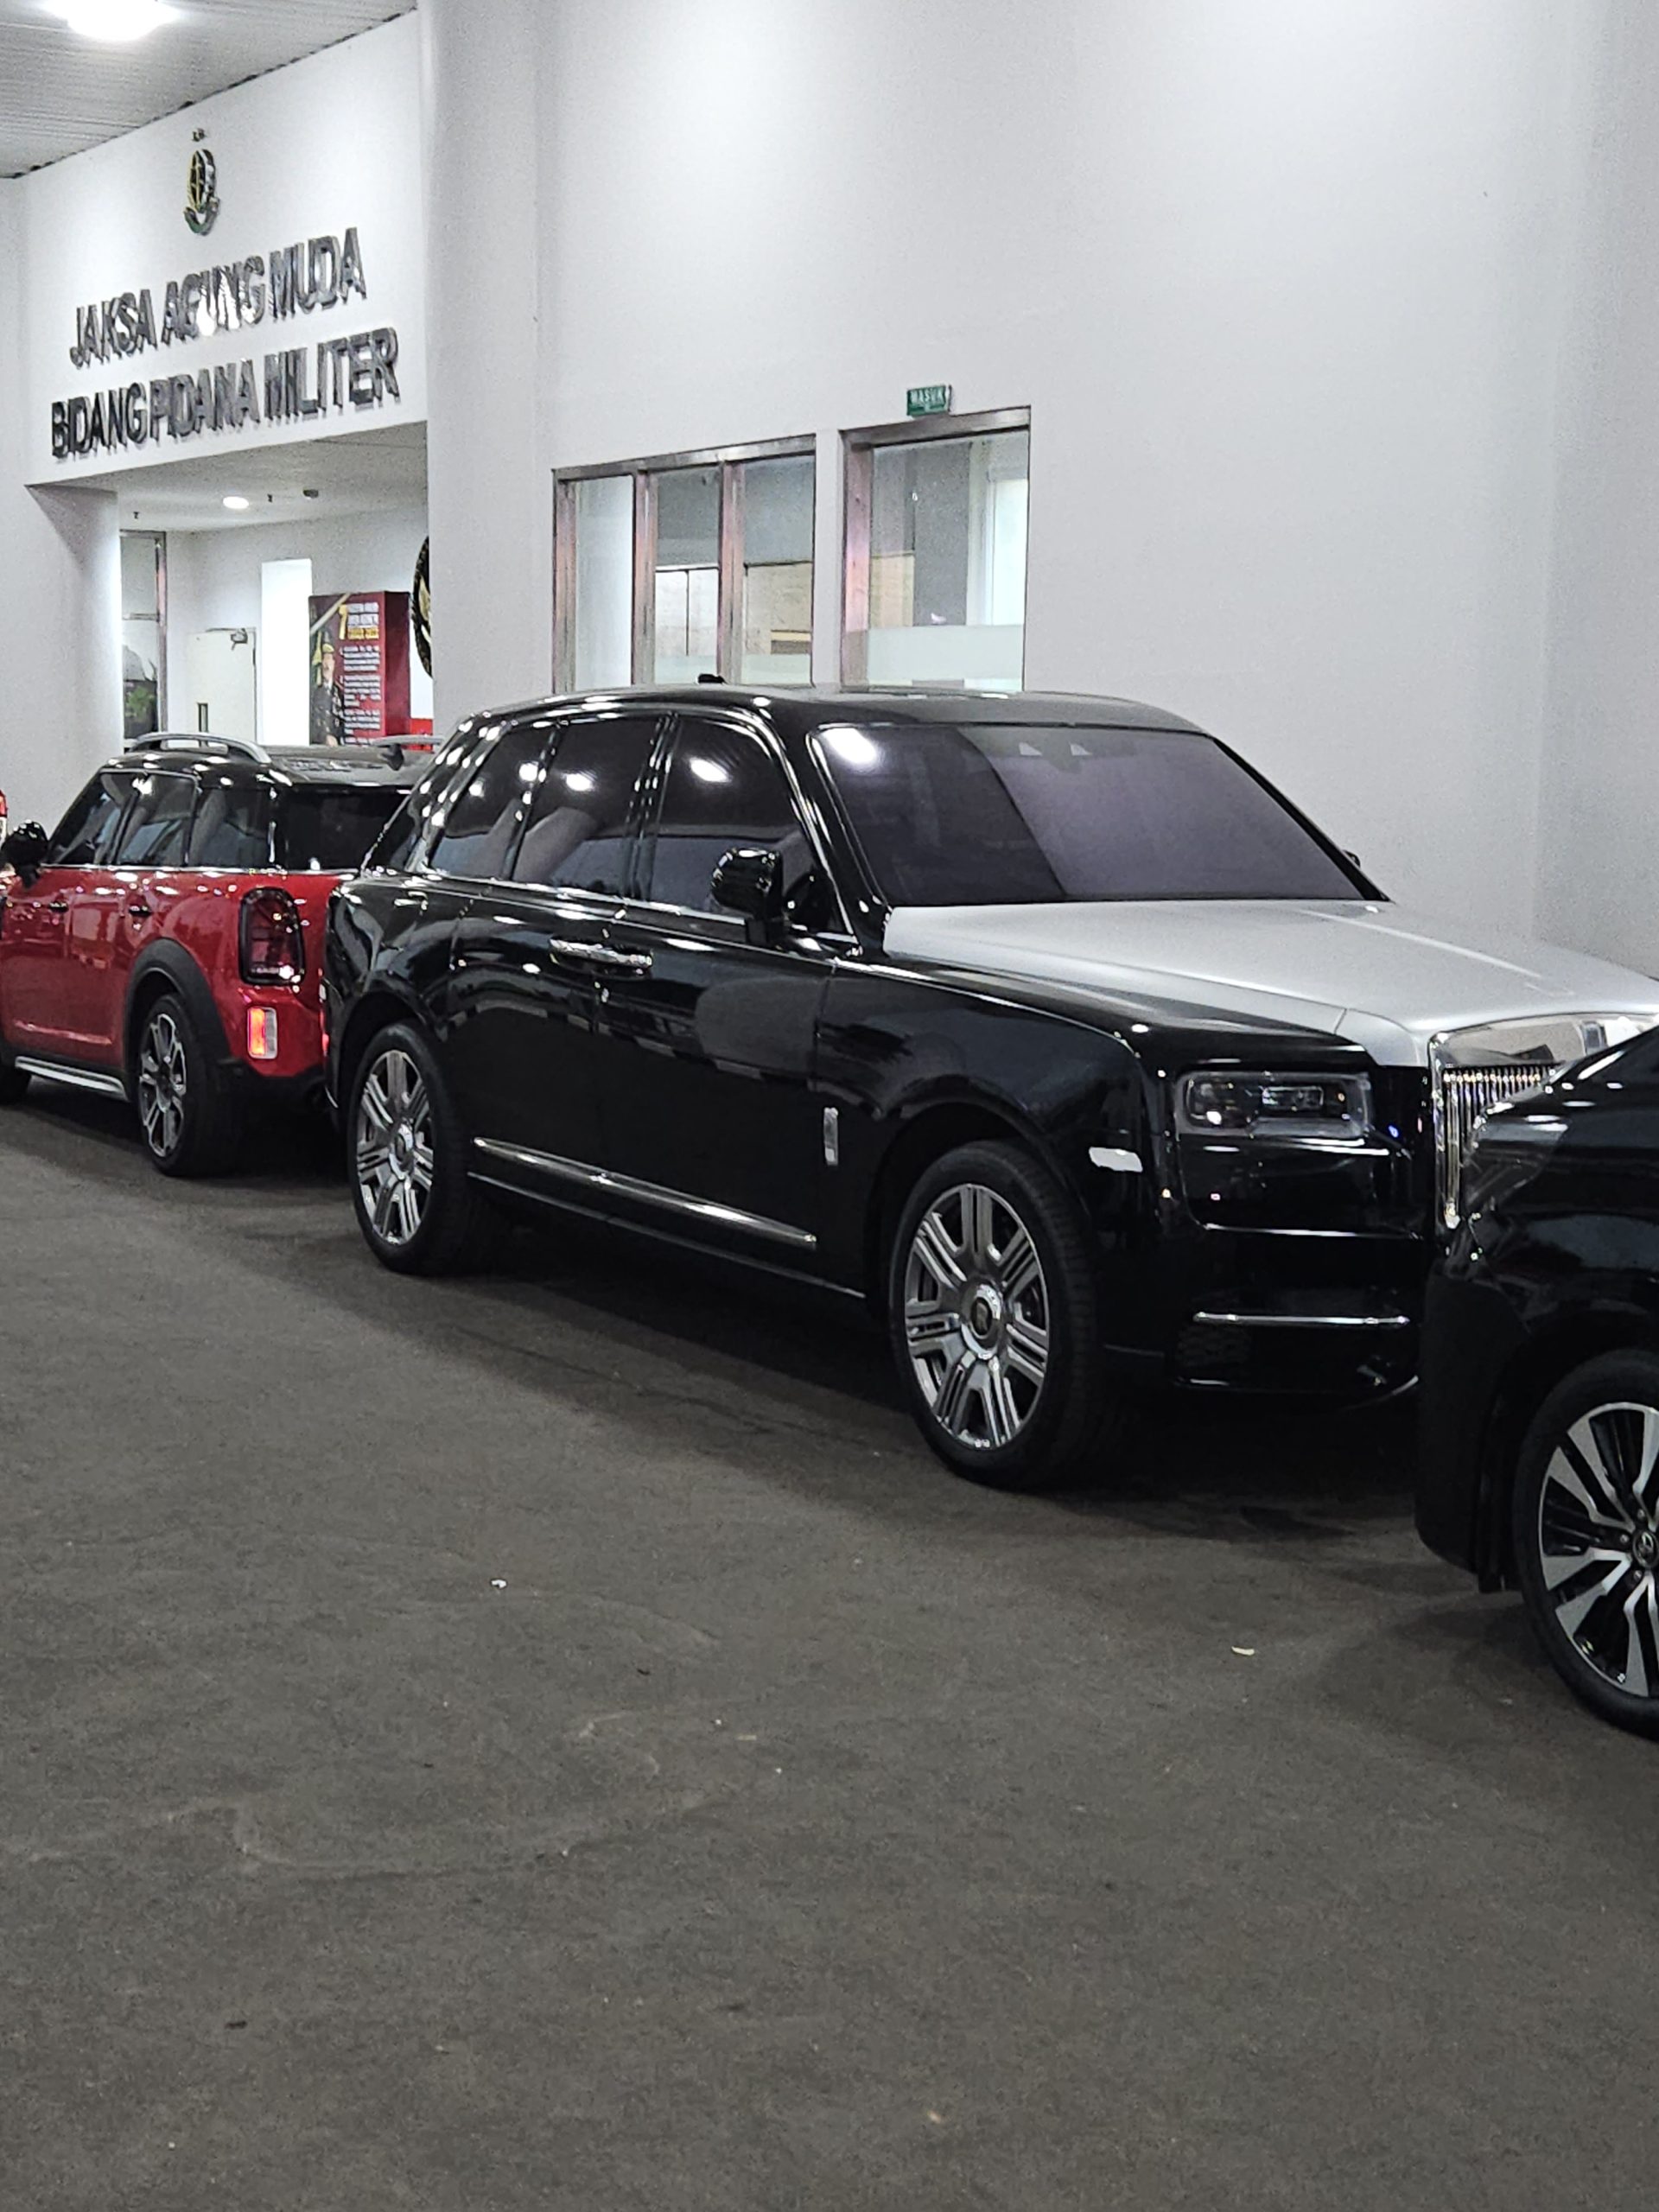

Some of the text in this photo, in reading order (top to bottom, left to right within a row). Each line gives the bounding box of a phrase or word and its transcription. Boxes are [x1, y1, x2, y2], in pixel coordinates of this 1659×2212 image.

[69, 226, 367, 368] JAKSA AGUNG MUDA
[52, 327, 400, 458] BIDANG PIDANA MILITER
